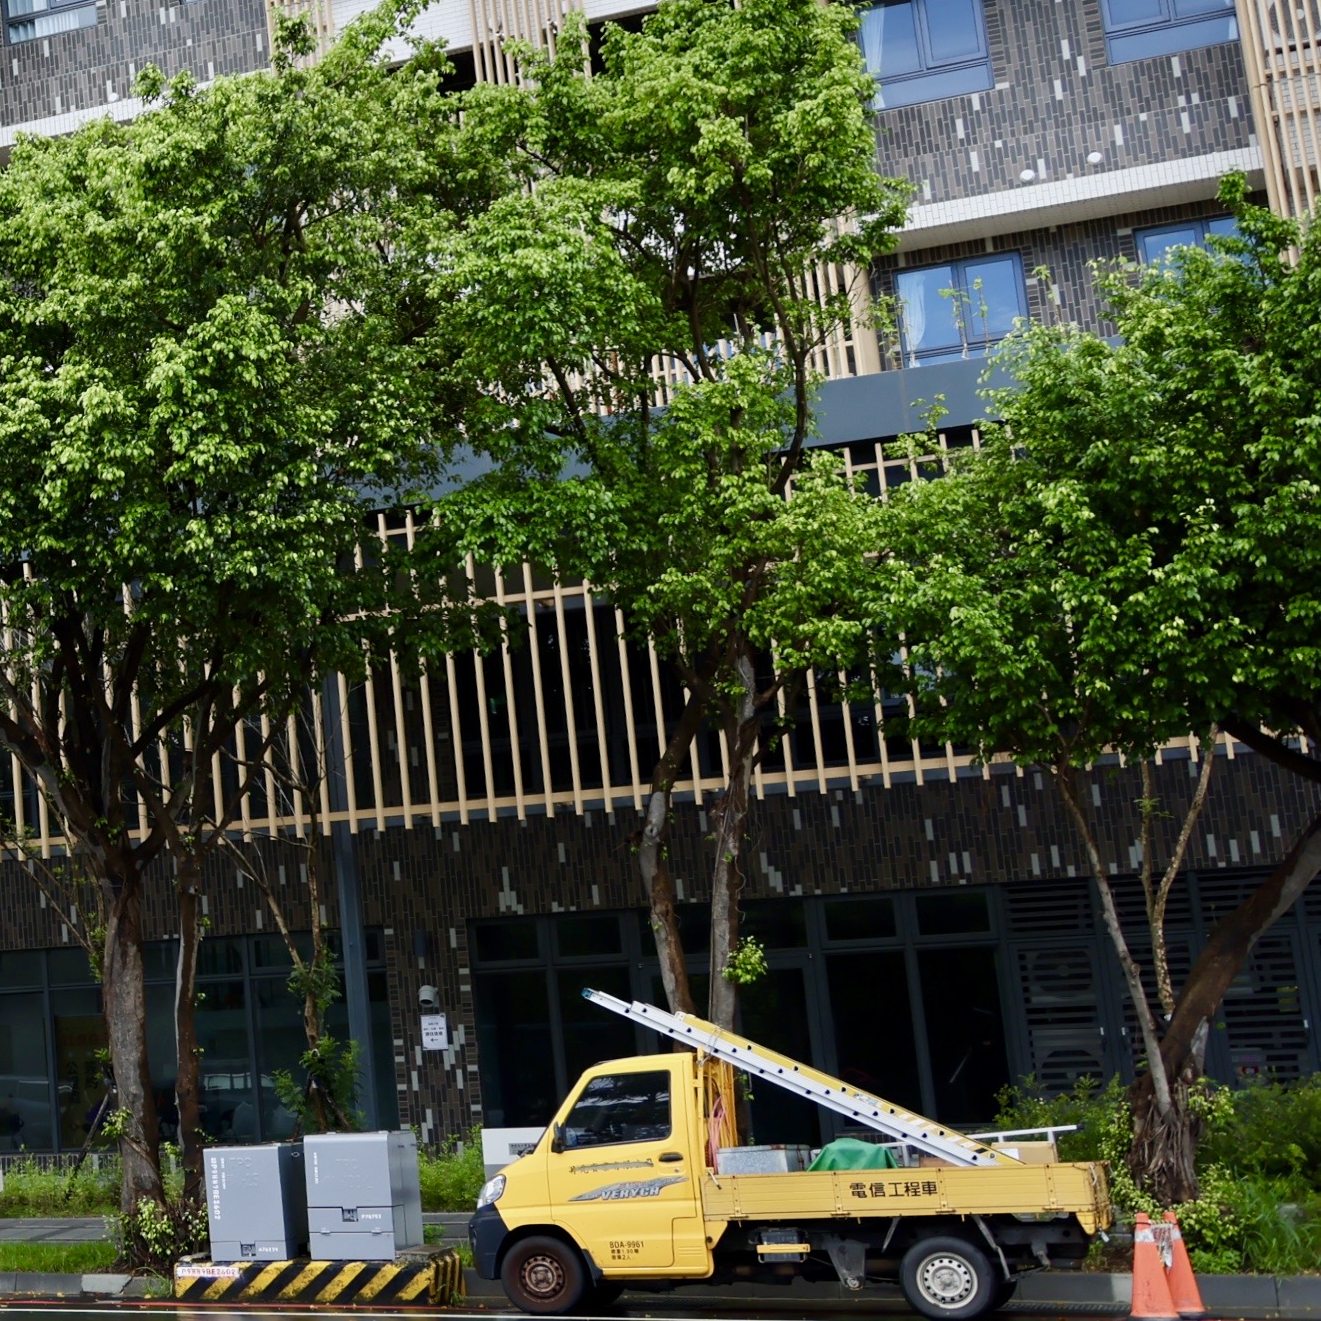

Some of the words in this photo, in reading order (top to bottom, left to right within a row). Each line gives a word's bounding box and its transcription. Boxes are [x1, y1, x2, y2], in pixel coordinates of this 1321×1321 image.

[850, 1181, 937, 1198] 電信工程車
